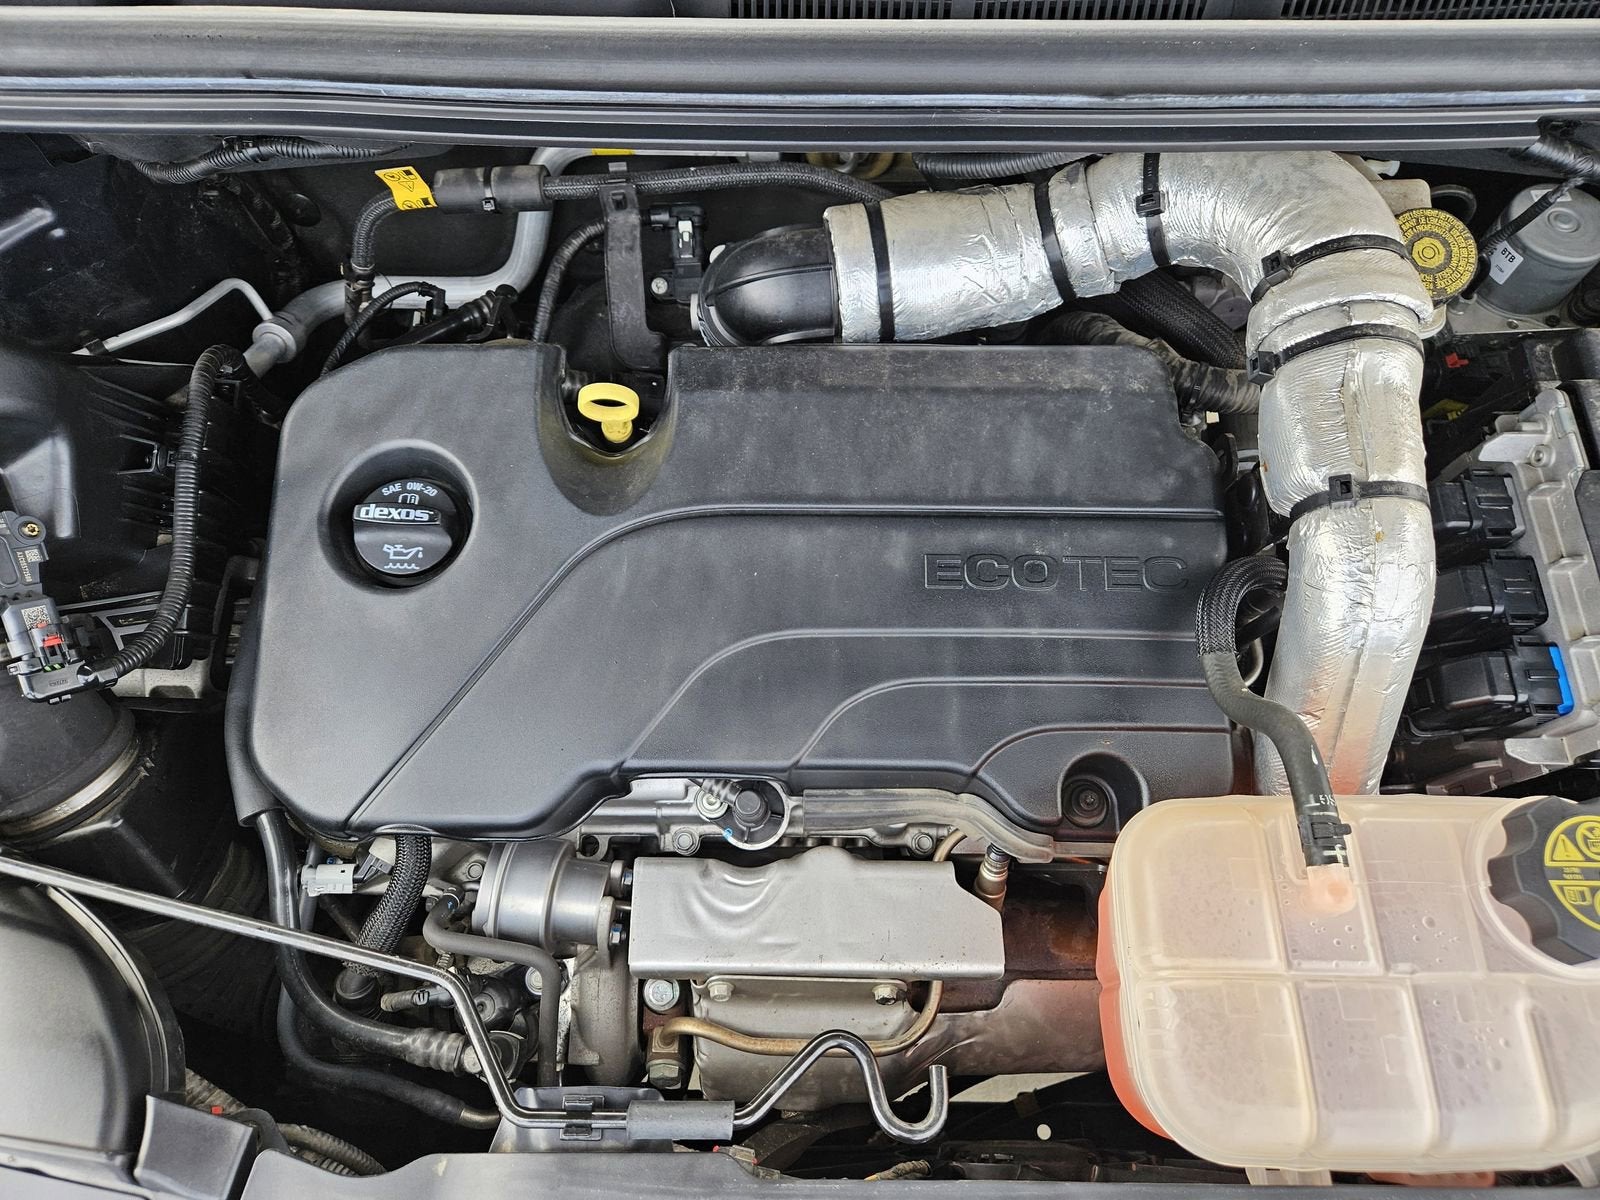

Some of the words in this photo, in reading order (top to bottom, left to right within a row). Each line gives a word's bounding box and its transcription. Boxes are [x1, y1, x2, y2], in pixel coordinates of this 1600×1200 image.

[382, 483, 402, 496] SAE
[406, 482, 438, 496] 0W-20
[360, 504, 434, 521] dexos
[923, 553, 1189, 593] ECOTEC
